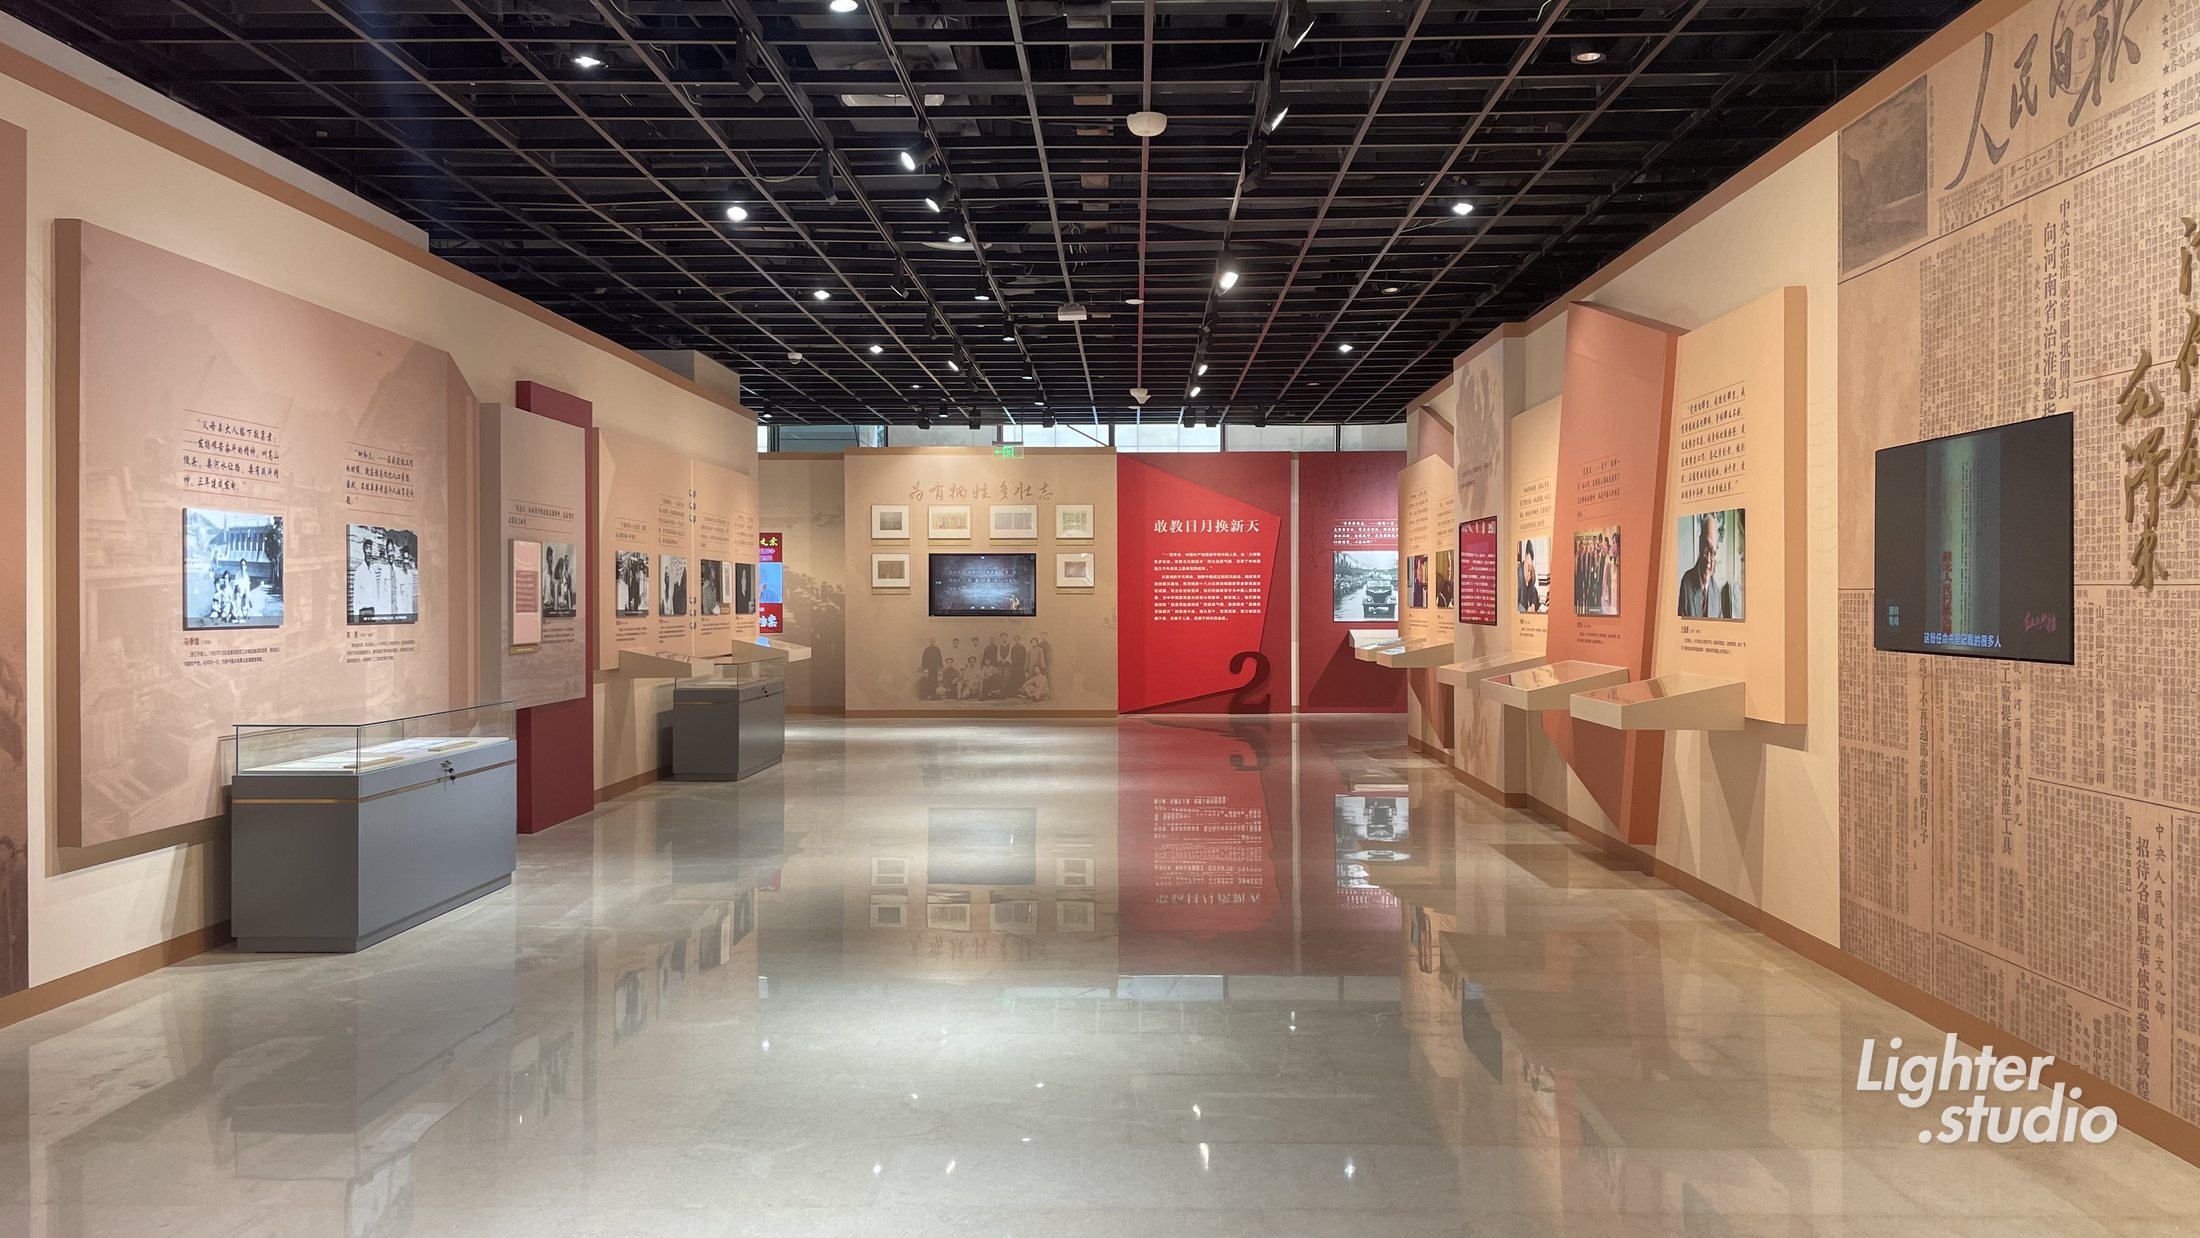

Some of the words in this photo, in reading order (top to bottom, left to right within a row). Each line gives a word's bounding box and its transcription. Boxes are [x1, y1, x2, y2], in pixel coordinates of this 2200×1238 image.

[1153, 519, 1261, 533] 敢教日月换新天
[1923, 631, 2002, 648] 这份任命书里记载的很多人
[1229, 651, 1271, 714] 2
[2154, 822, 2166, 1019] 中央人民政府文化部
